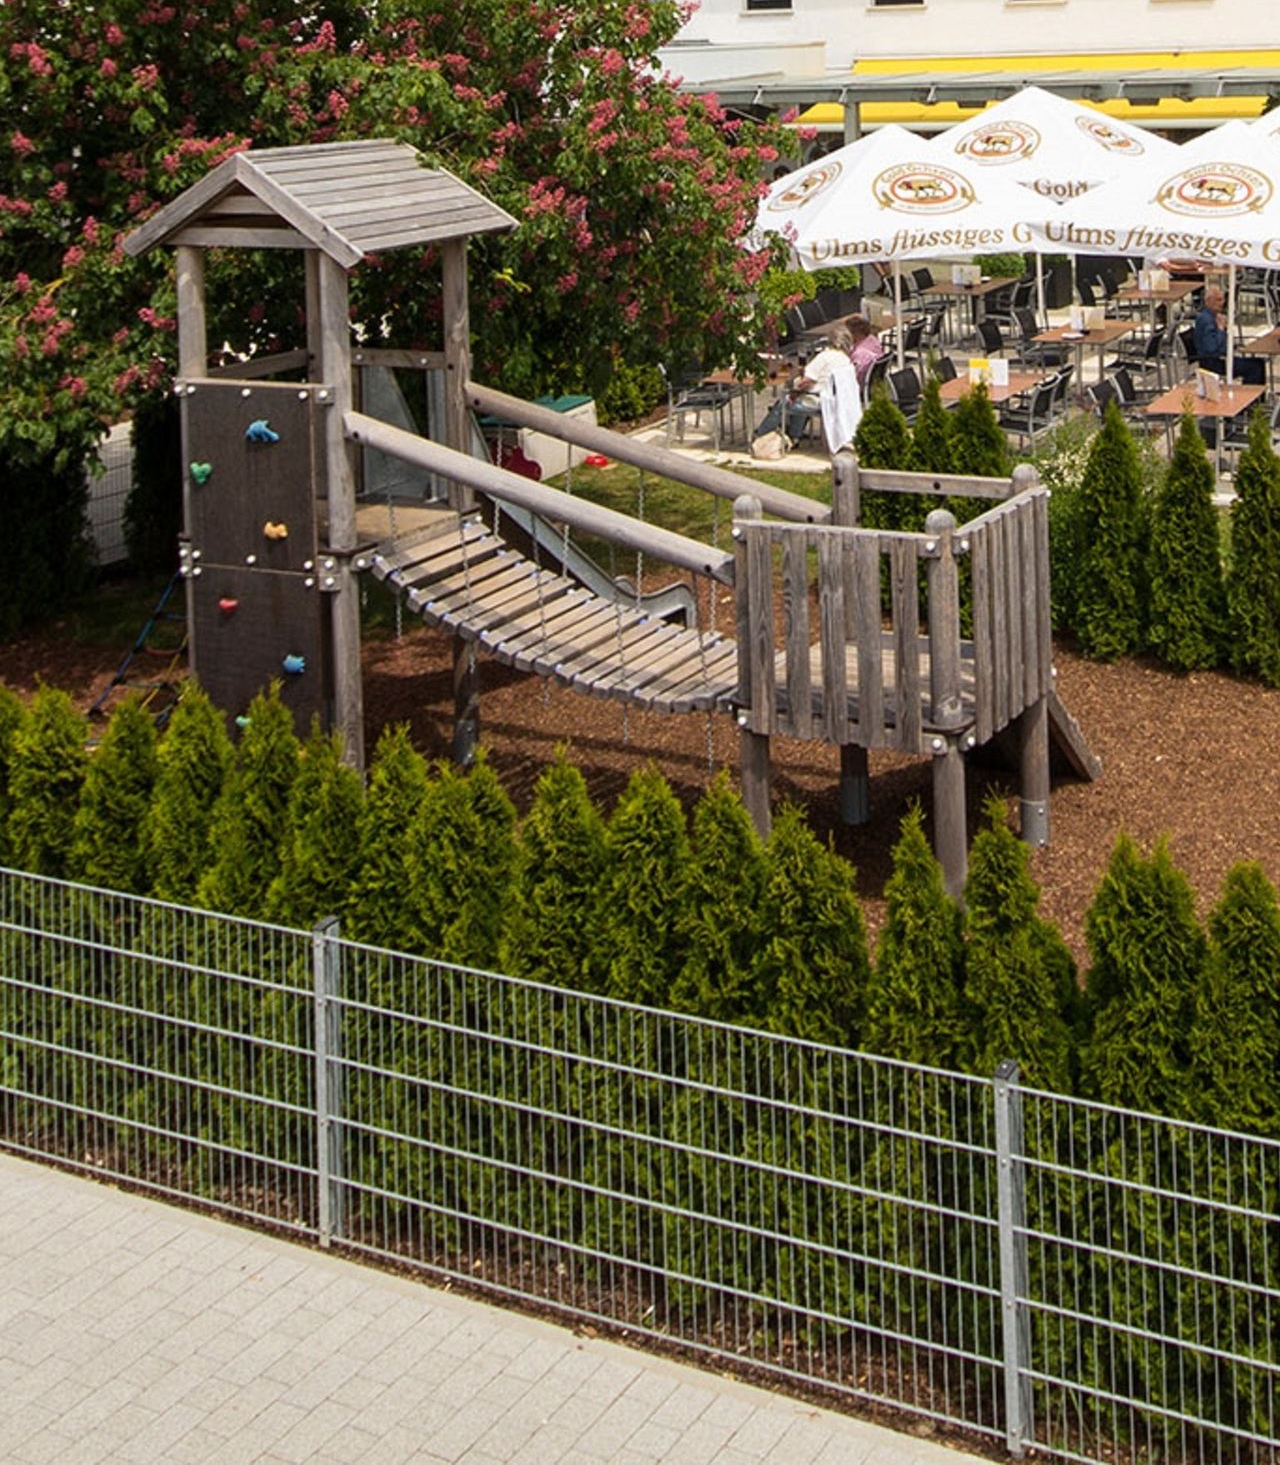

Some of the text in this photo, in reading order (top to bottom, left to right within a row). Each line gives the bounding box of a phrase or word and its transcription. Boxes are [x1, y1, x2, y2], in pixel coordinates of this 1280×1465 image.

[810, 237, 883, 261] Ulms
[885, 225, 1004, 256] flüssiges
[1044, 220, 1116, 246] Ulms
[1118, 225, 1253, 259] flüssiges
